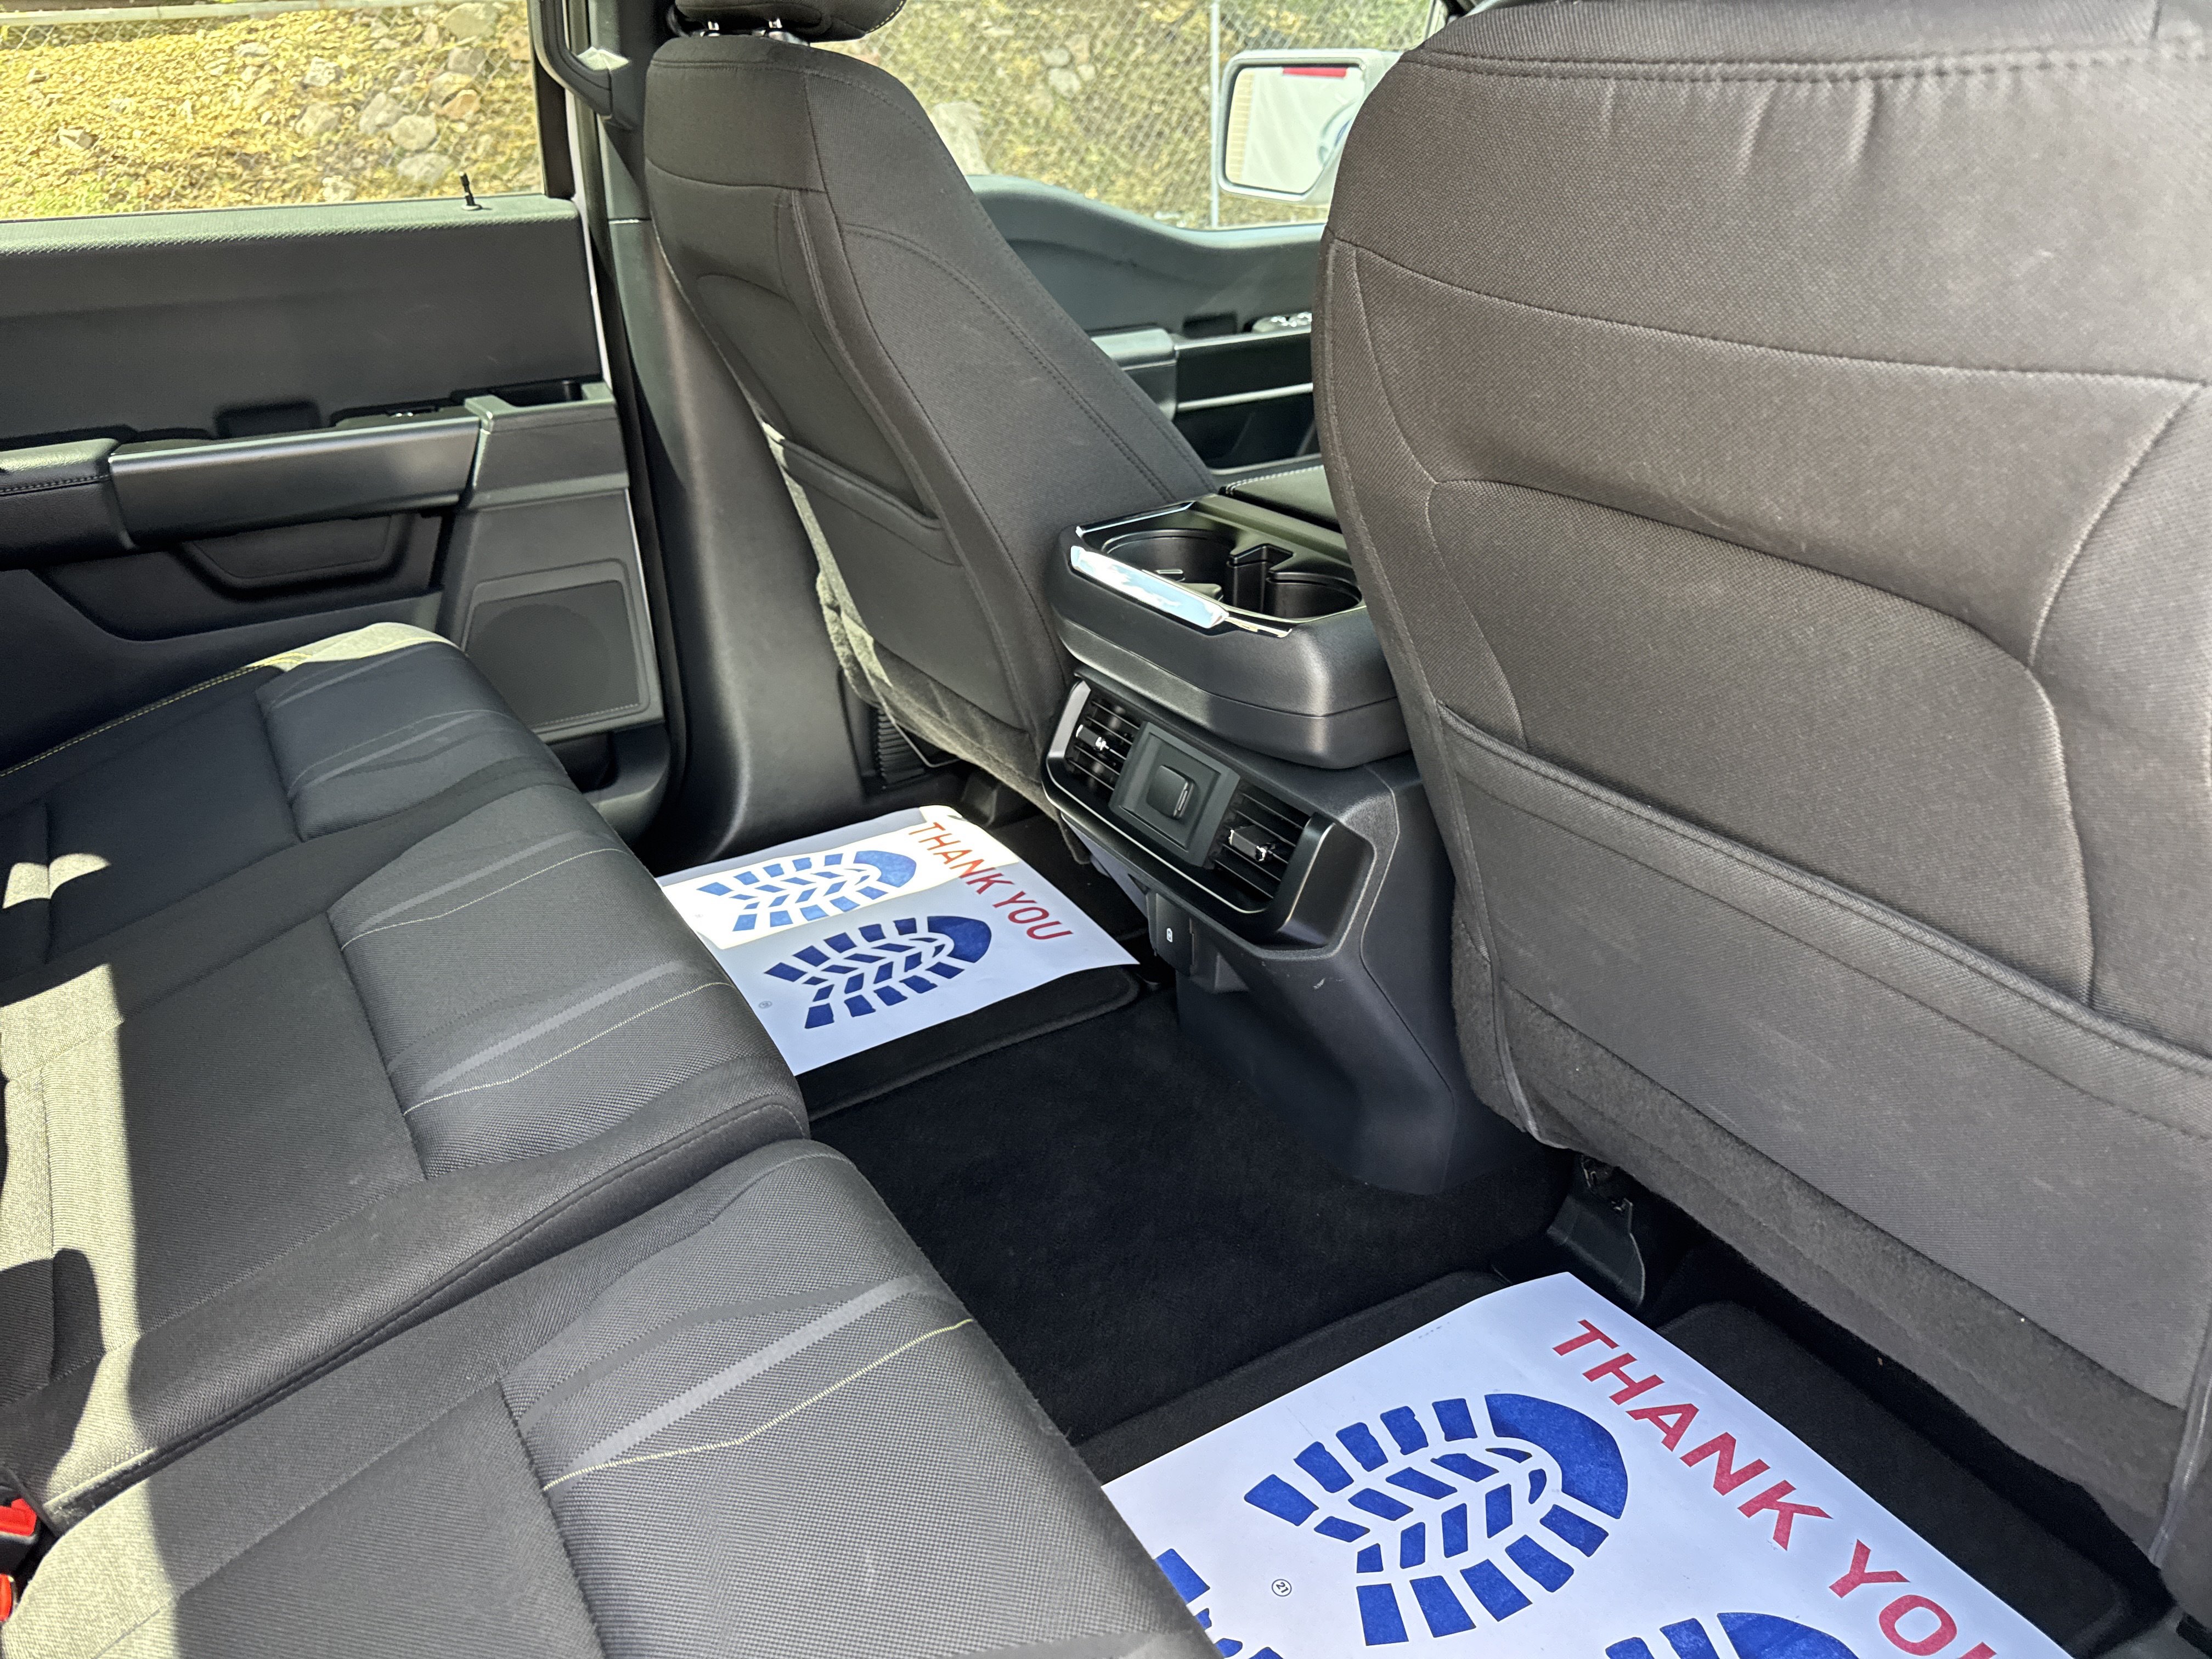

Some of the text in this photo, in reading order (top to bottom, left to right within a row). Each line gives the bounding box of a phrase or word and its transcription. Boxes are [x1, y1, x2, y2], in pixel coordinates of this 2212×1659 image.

[908, 822, 1074, 940] THANK YOU
[1552, 1319, 1997, 1659] THANK YO
[1276, 1582, 1289, 1593] 21
